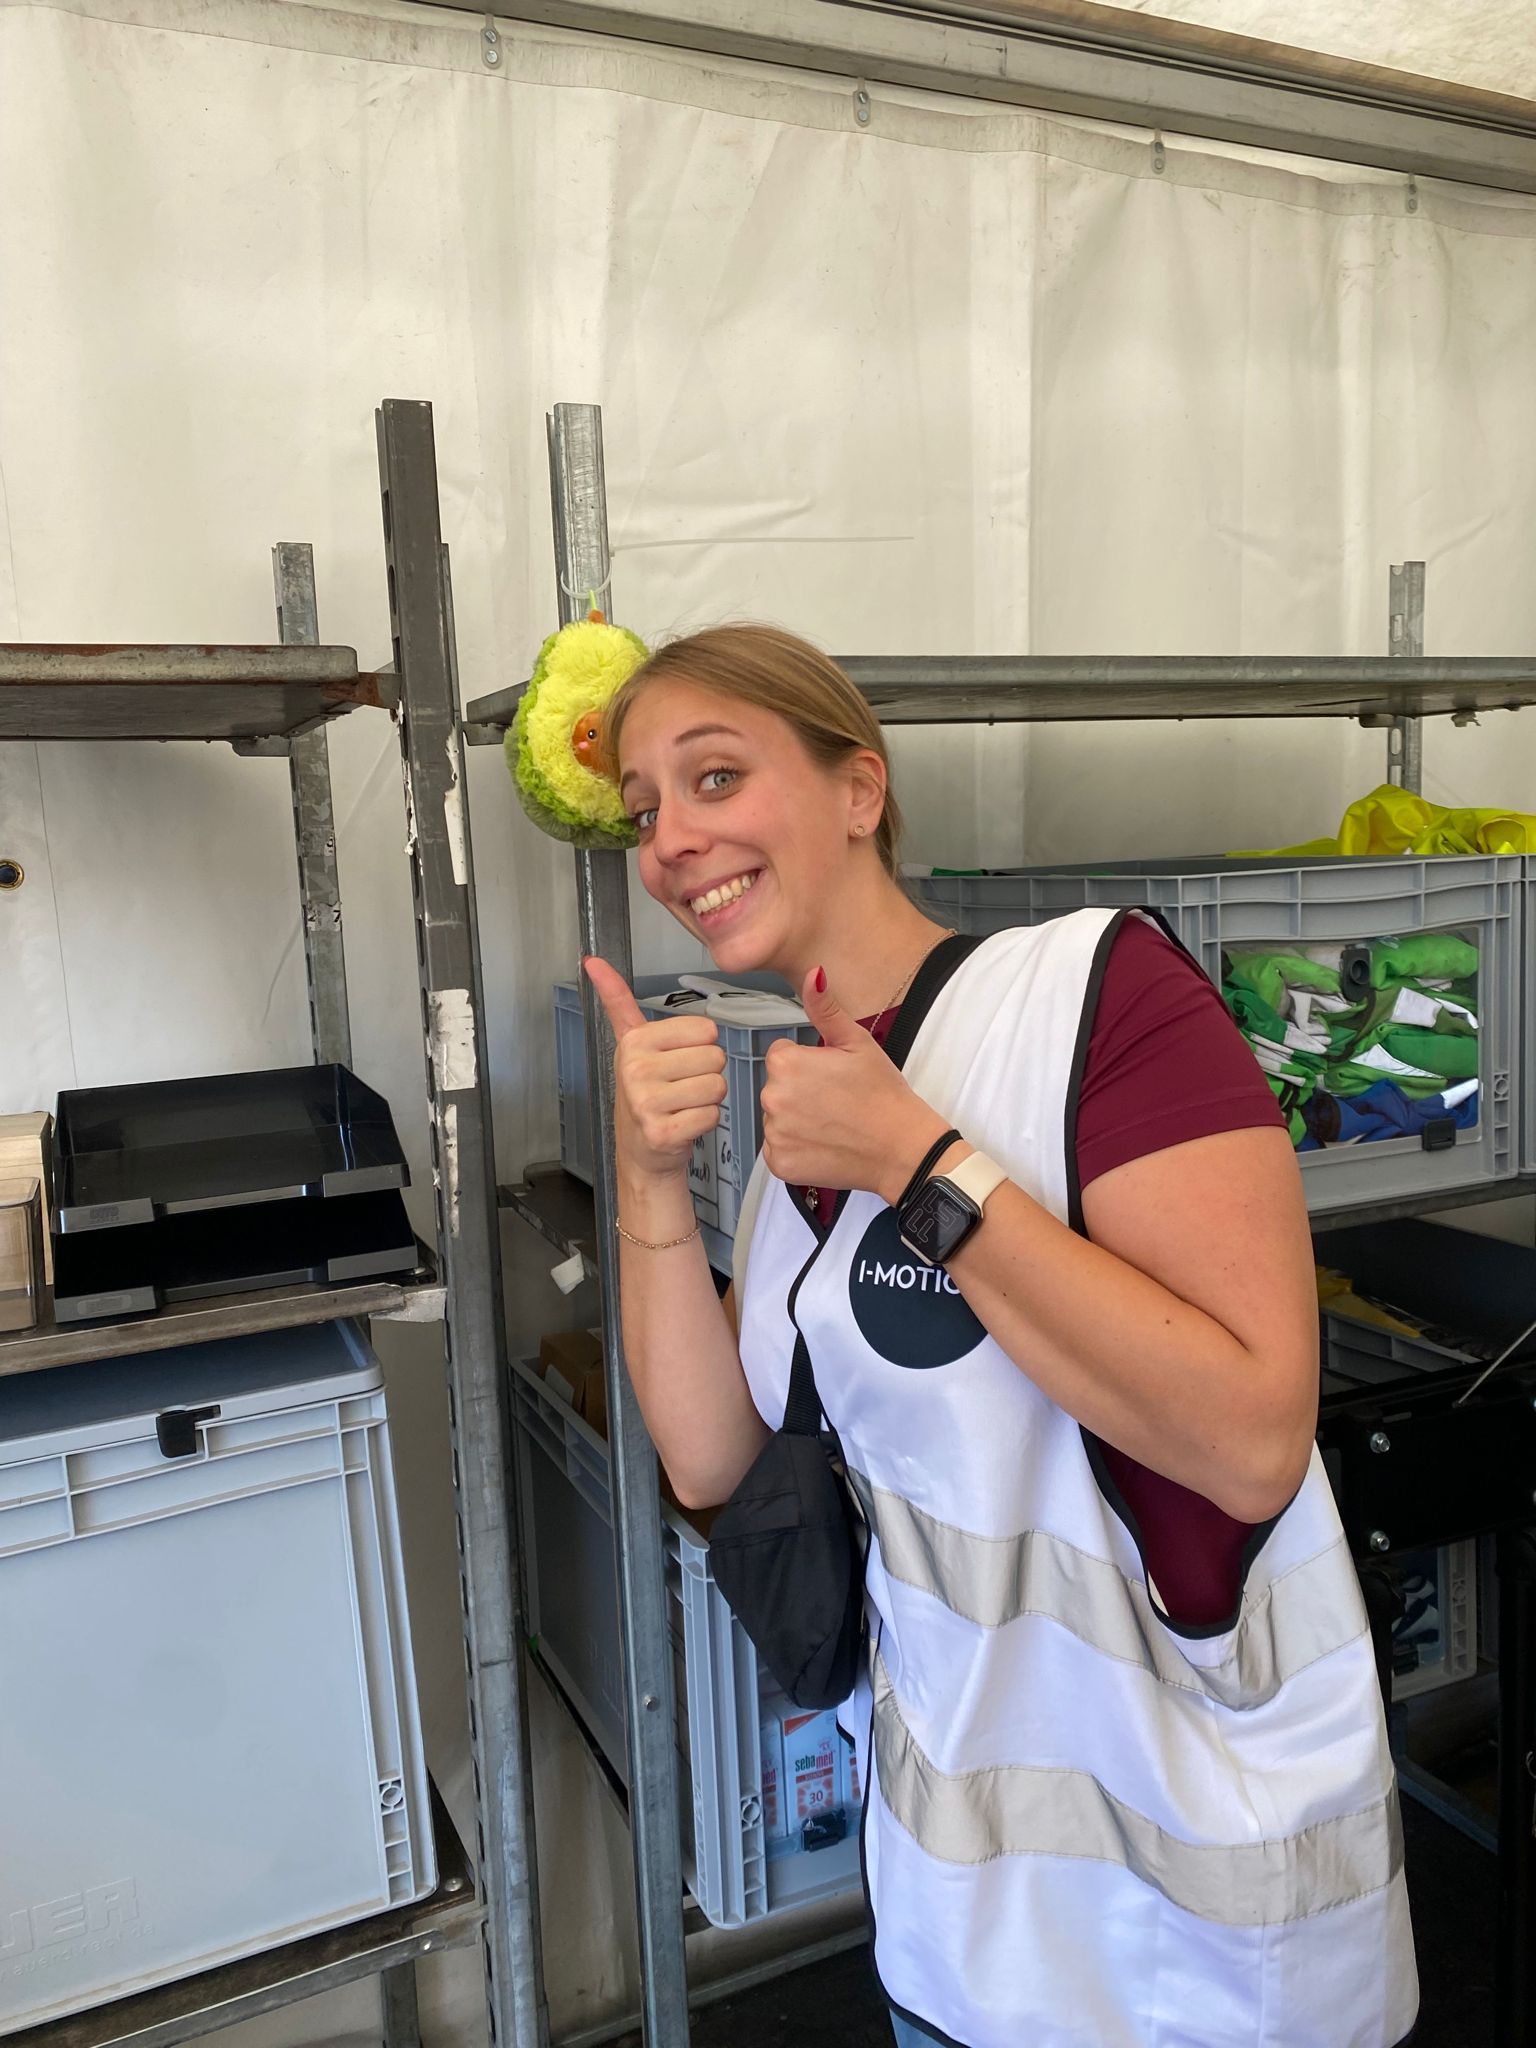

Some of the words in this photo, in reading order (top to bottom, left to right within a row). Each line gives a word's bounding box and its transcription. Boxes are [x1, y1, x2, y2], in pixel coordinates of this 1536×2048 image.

[858, 1259, 960, 1295] I-MOTIO
[795, 1750, 834, 1773] sebamed
[809, 1790, 824, 1805] 30
[0, 1876, 140, 1962] UER
